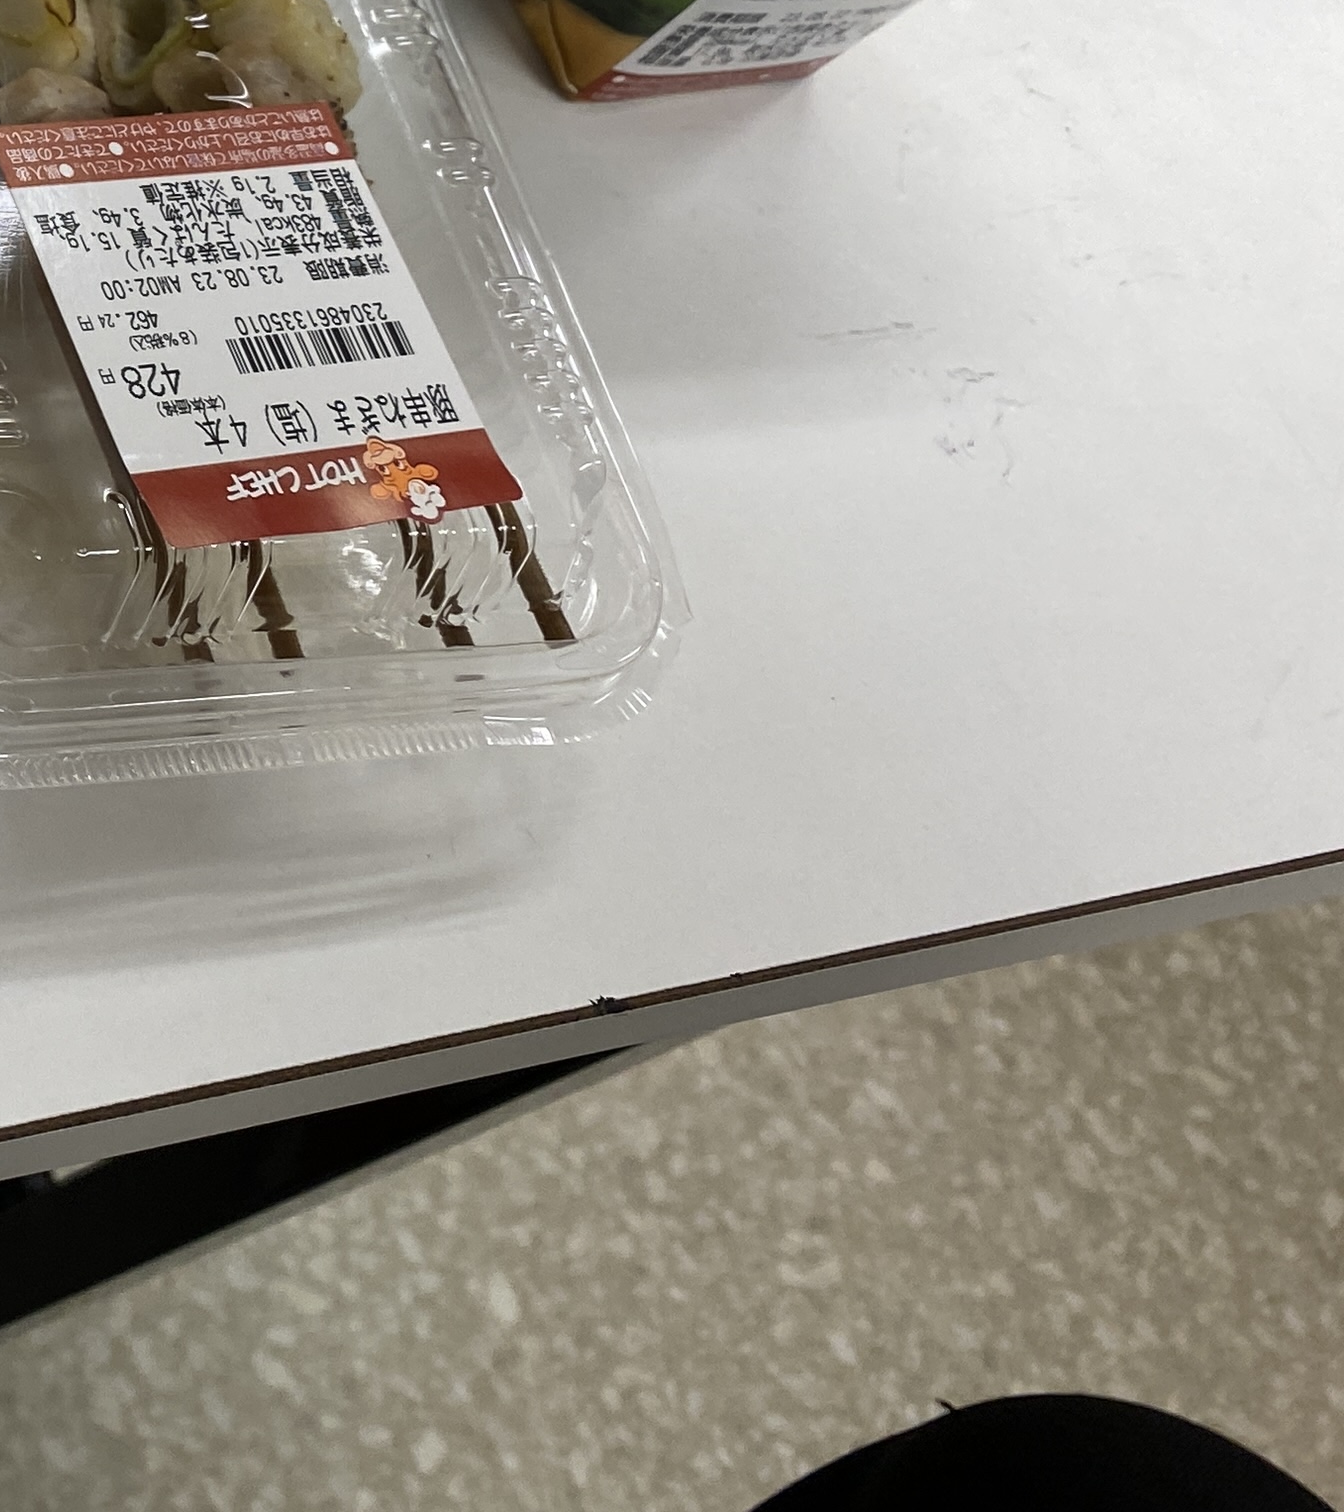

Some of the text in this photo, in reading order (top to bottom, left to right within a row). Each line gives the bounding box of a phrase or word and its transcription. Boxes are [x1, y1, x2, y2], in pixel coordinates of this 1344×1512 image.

[229, 173, 276, 194] 2.1g
[97, 252, 391, 300] 消費期限 23.08.23 AM02:00
[231, 301, 388, 335] 2304861335010
[117, 359, 189, 399] 428
[218, 455, 367, 501] HOT CHEF
